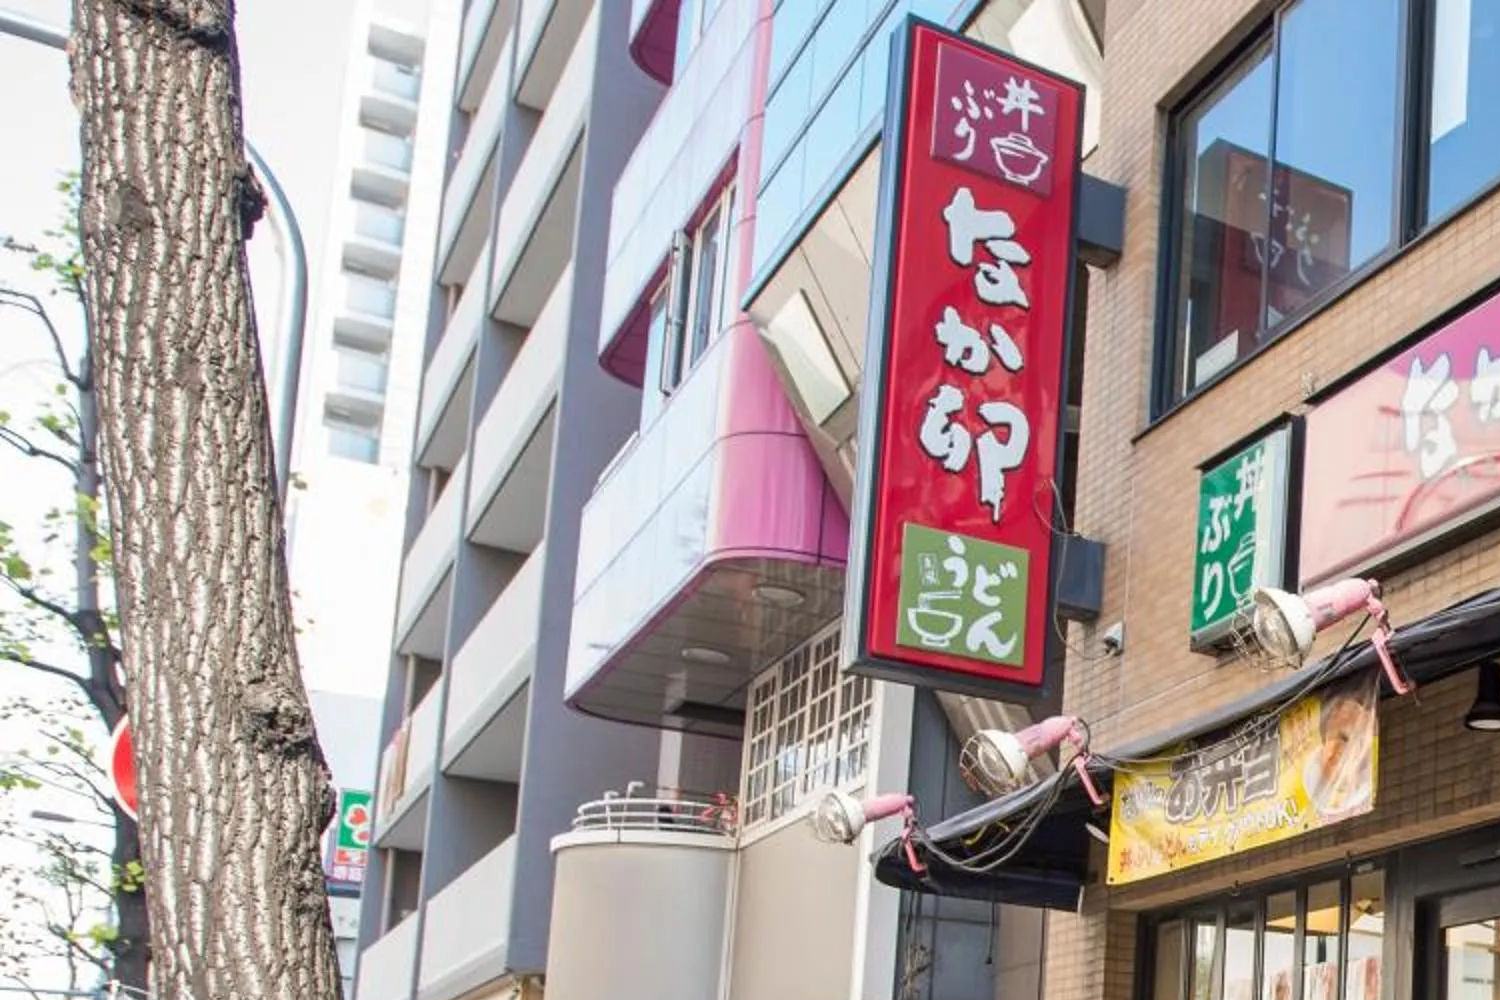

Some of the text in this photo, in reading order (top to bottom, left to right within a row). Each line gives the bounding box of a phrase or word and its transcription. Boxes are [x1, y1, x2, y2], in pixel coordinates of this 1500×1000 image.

[919, 186, 1030, 523] なか卯
[943, 535, 1019, 659] うどん
